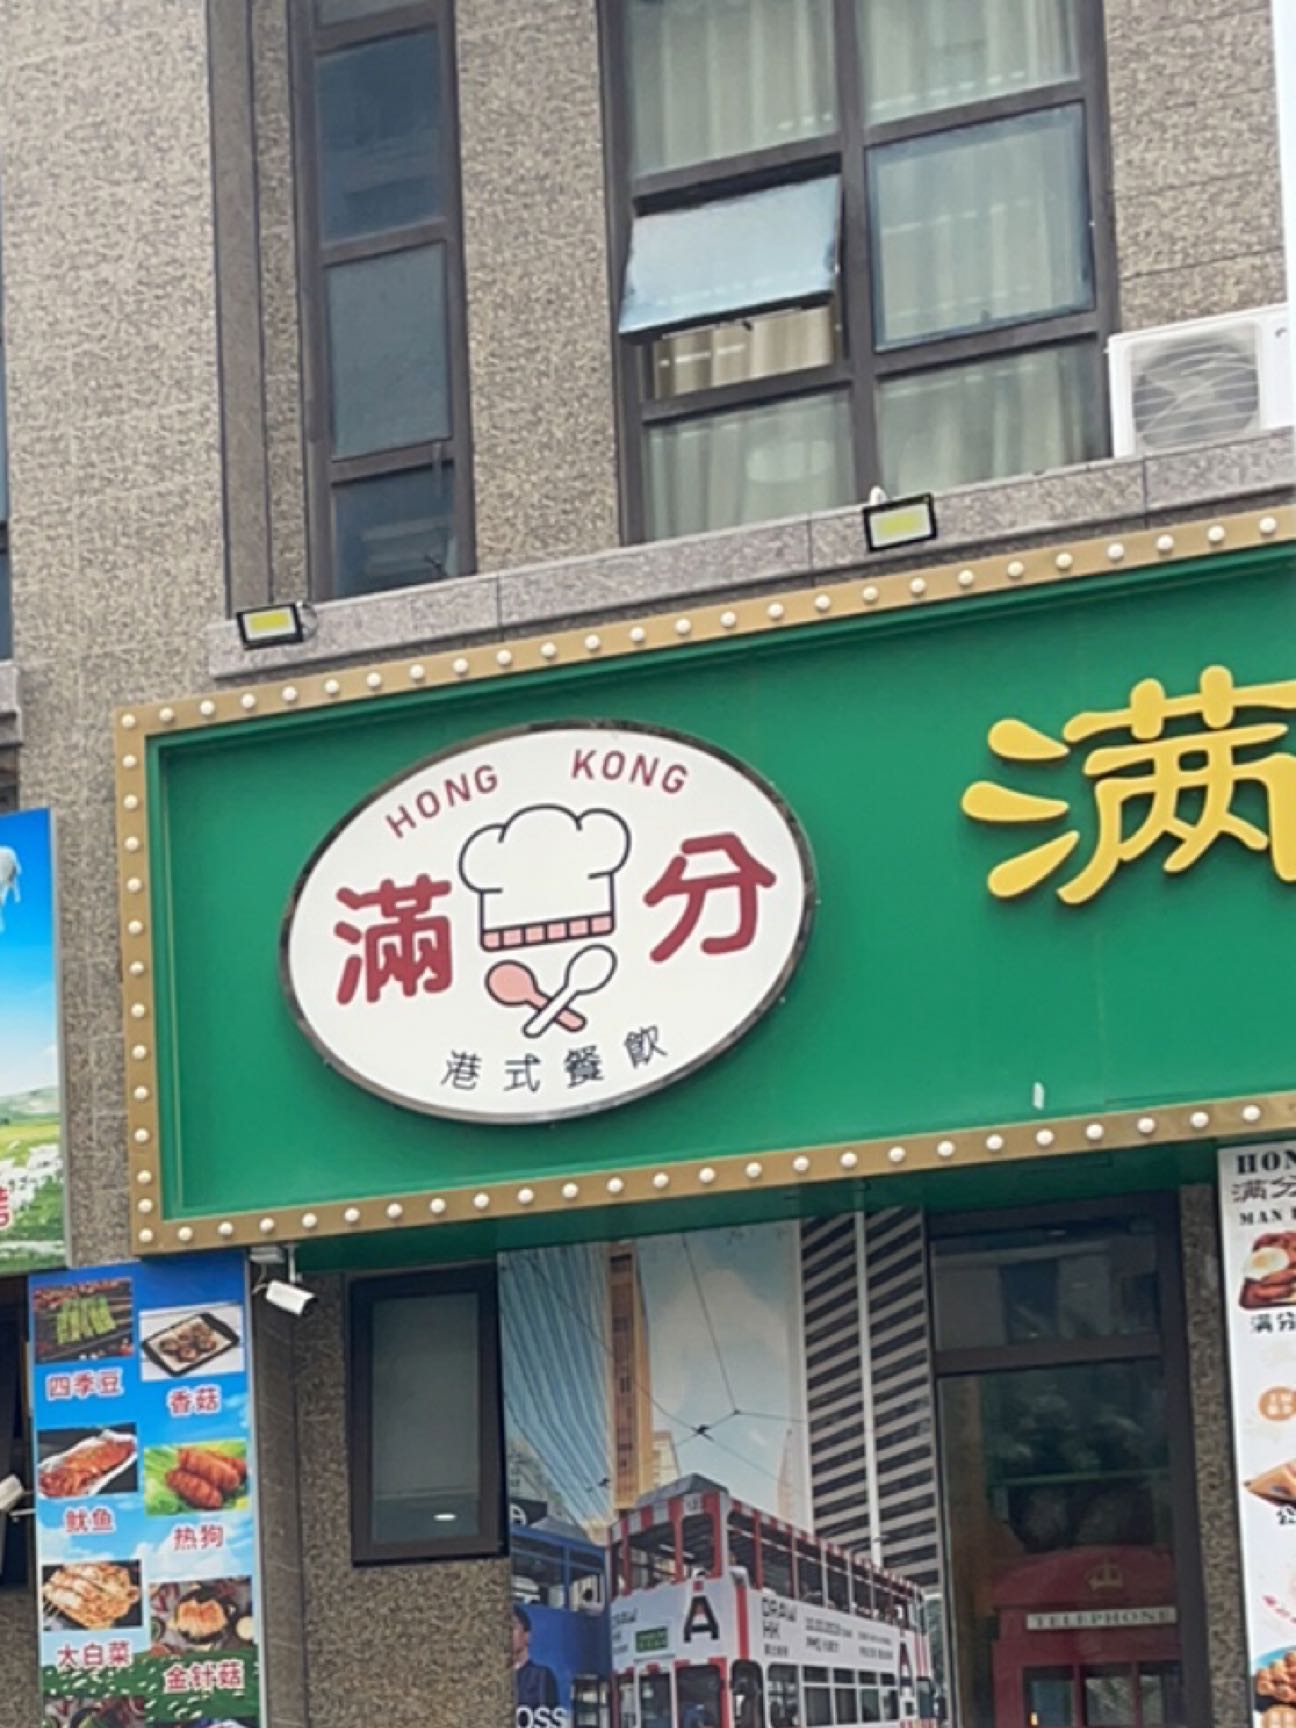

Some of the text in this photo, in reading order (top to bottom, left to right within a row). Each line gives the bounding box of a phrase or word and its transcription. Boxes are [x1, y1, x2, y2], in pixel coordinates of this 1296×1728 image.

[386, 749, 689, 838] HONG KONG
[440, 1026, 667, 1093] 港式餐飲
[47, 1370, 120, 1398] 四季豆
[169, 1387, 219, 1415] 香菇
[65, 1507, 113, 1533] 鱿鱼
[174, 1524, 224, 1550] 热狗
[683, 1595, 719, 1642] A
[57, 1641, 131, 1669] 大白菜
[165, 1662, 243, 1692] 金针菇
